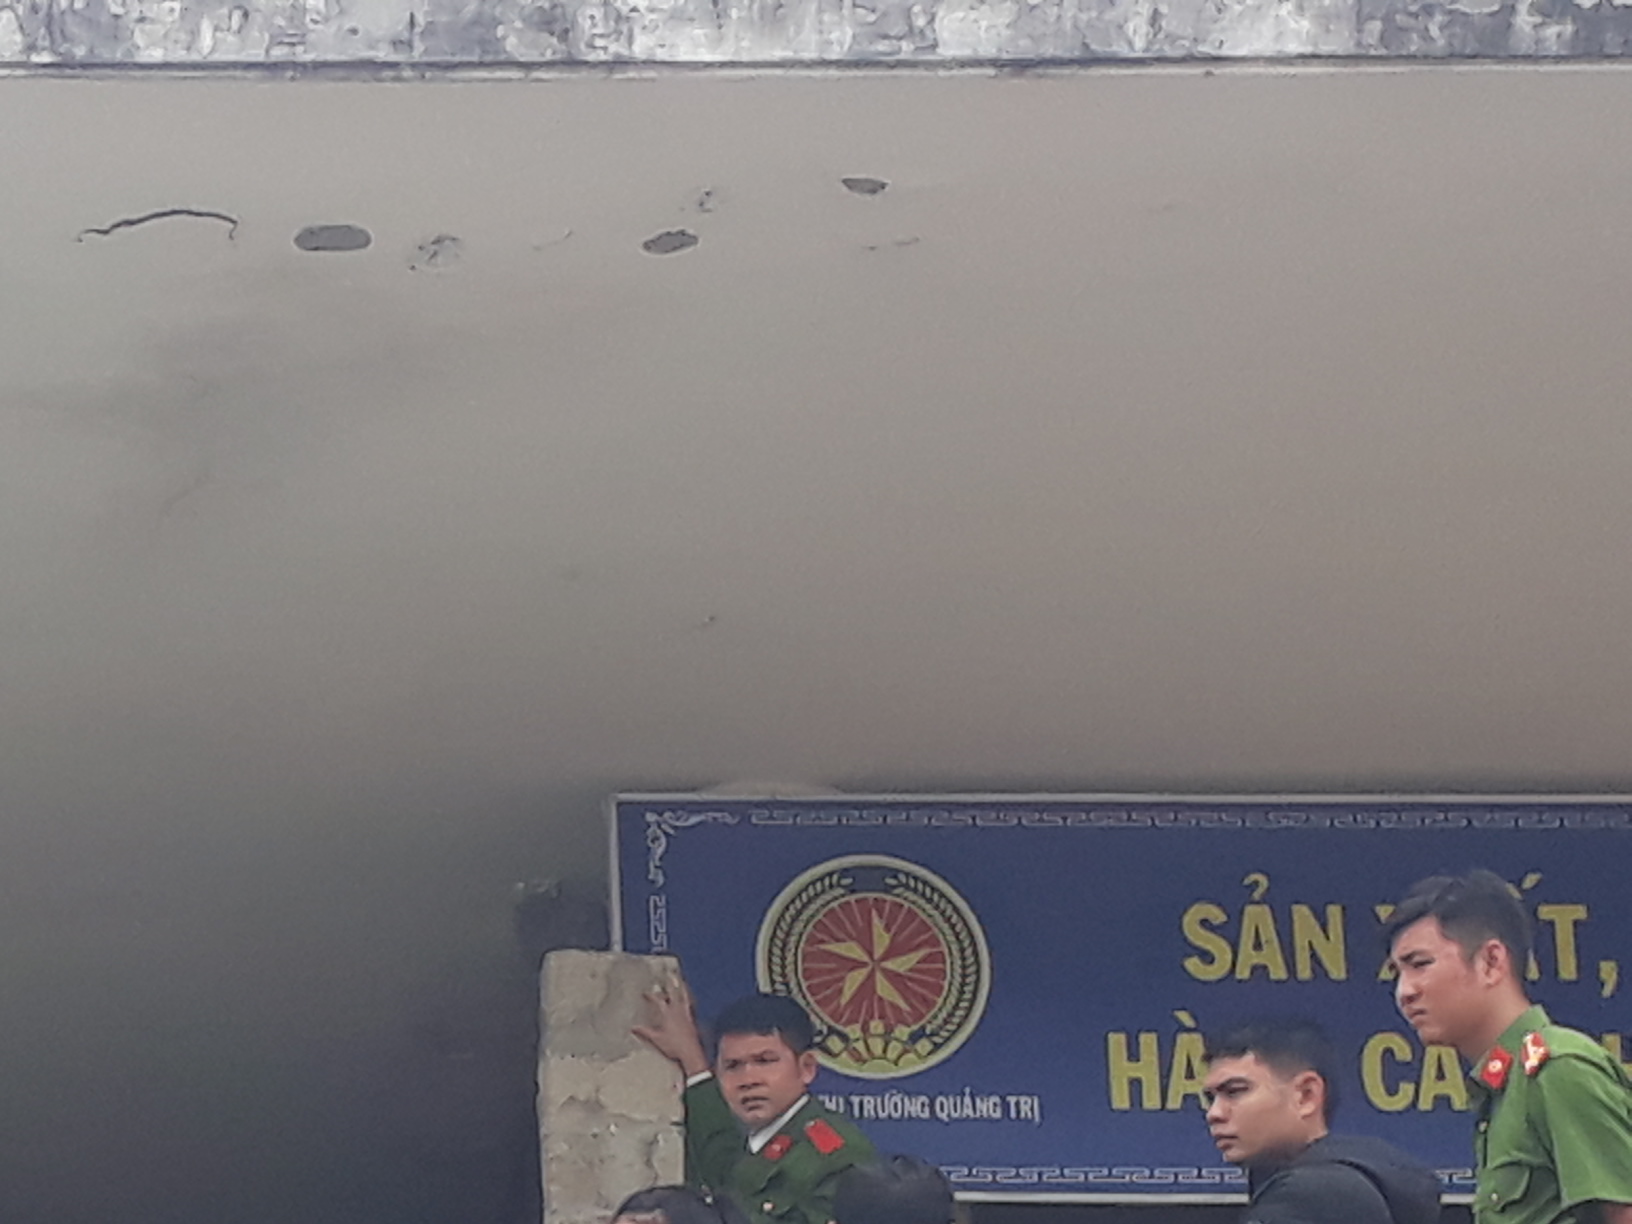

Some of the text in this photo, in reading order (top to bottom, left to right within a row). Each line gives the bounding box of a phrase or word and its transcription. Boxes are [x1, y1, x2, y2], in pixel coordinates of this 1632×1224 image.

[1181, 871, 1348, 982] SẢN
[935, 1086, 1002, 1122] QUẢNG
[1006, 1095, 1040, 1124] TRỊ
[1106, 1009, 1212, 1111] HÀ
